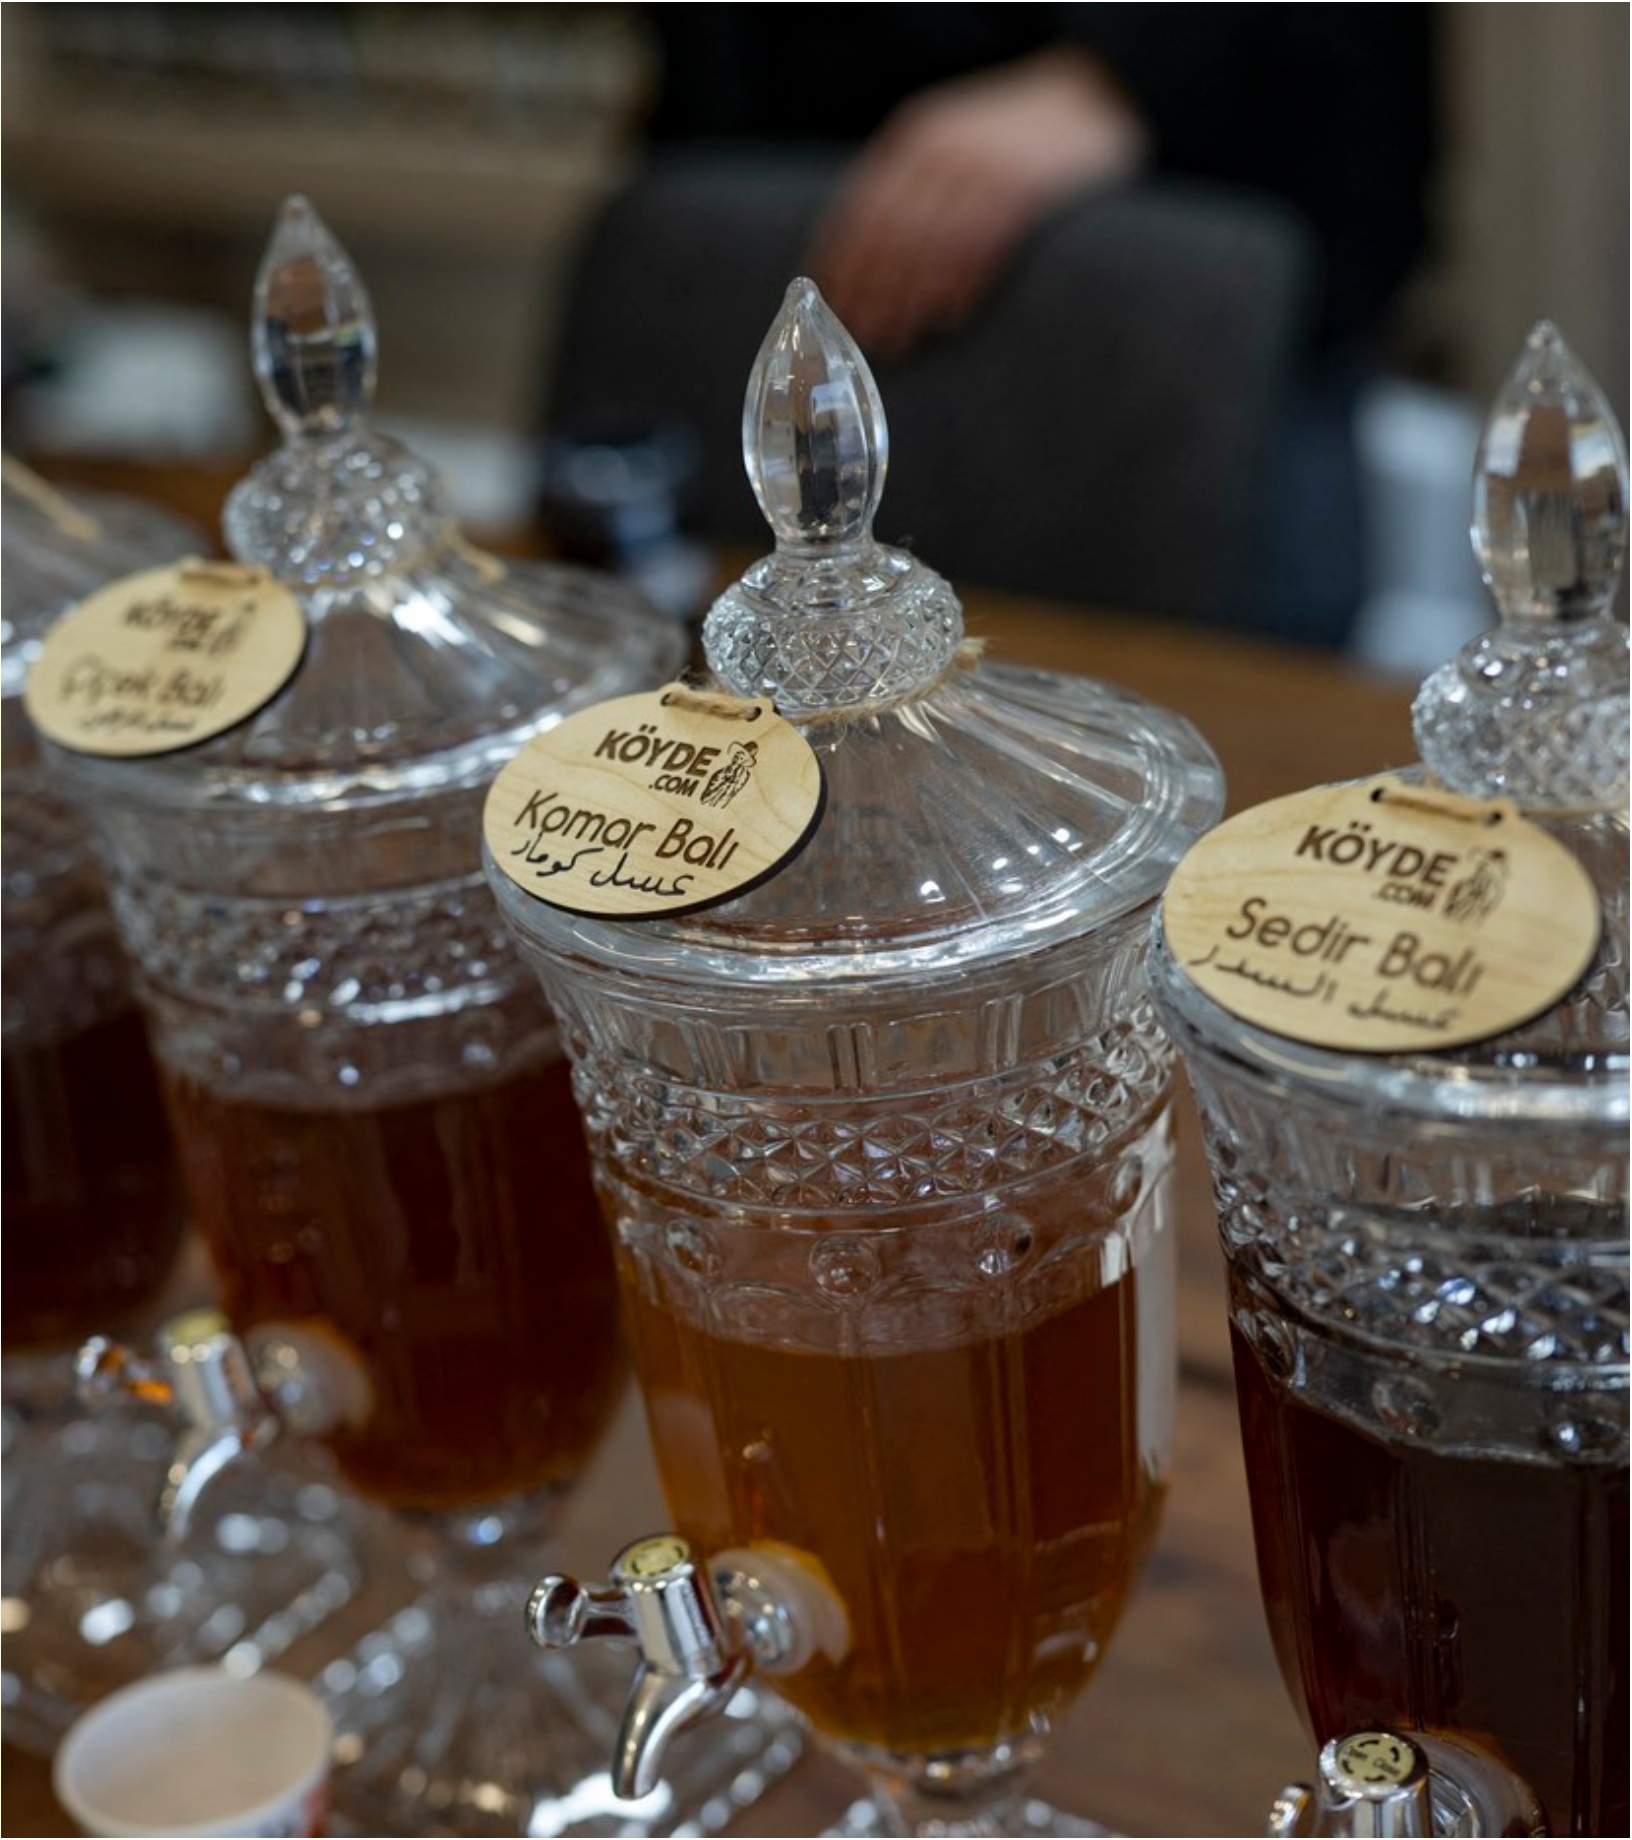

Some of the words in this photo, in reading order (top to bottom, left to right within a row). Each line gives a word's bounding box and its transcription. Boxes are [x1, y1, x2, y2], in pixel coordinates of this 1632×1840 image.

[594, 724, 722, 778] KÖYDE
[648, 774, 700, 797] .COM
[514, 789, 657, 850] Komar
[656, 818, 740, 871] Balı
[1295, 820, 1459, 887] KÖYDE
[590, 852, 695, 896] عسل
[1225, 896, 1370, 964] Sedir
[1377, 930, 1485, 997] Balı
